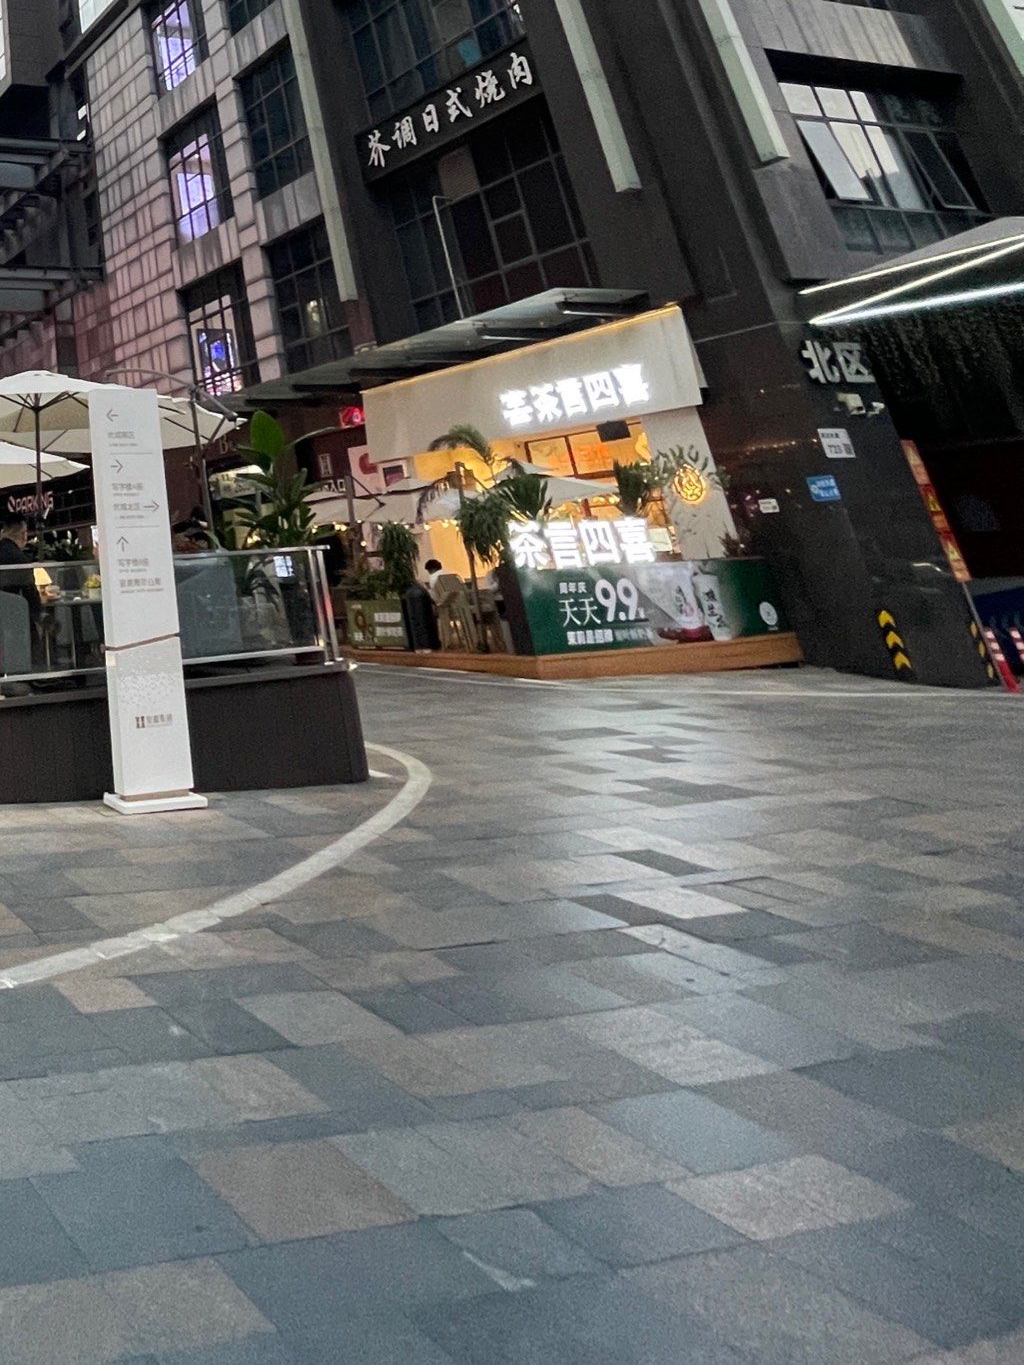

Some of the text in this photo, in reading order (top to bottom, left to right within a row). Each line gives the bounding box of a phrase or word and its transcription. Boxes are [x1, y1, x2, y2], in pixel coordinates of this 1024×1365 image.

[801, 340, 876, 384] 北区
[16, 491, 54, 515] PARKNG
[506, 516, 656, 570] 茶言四喜
